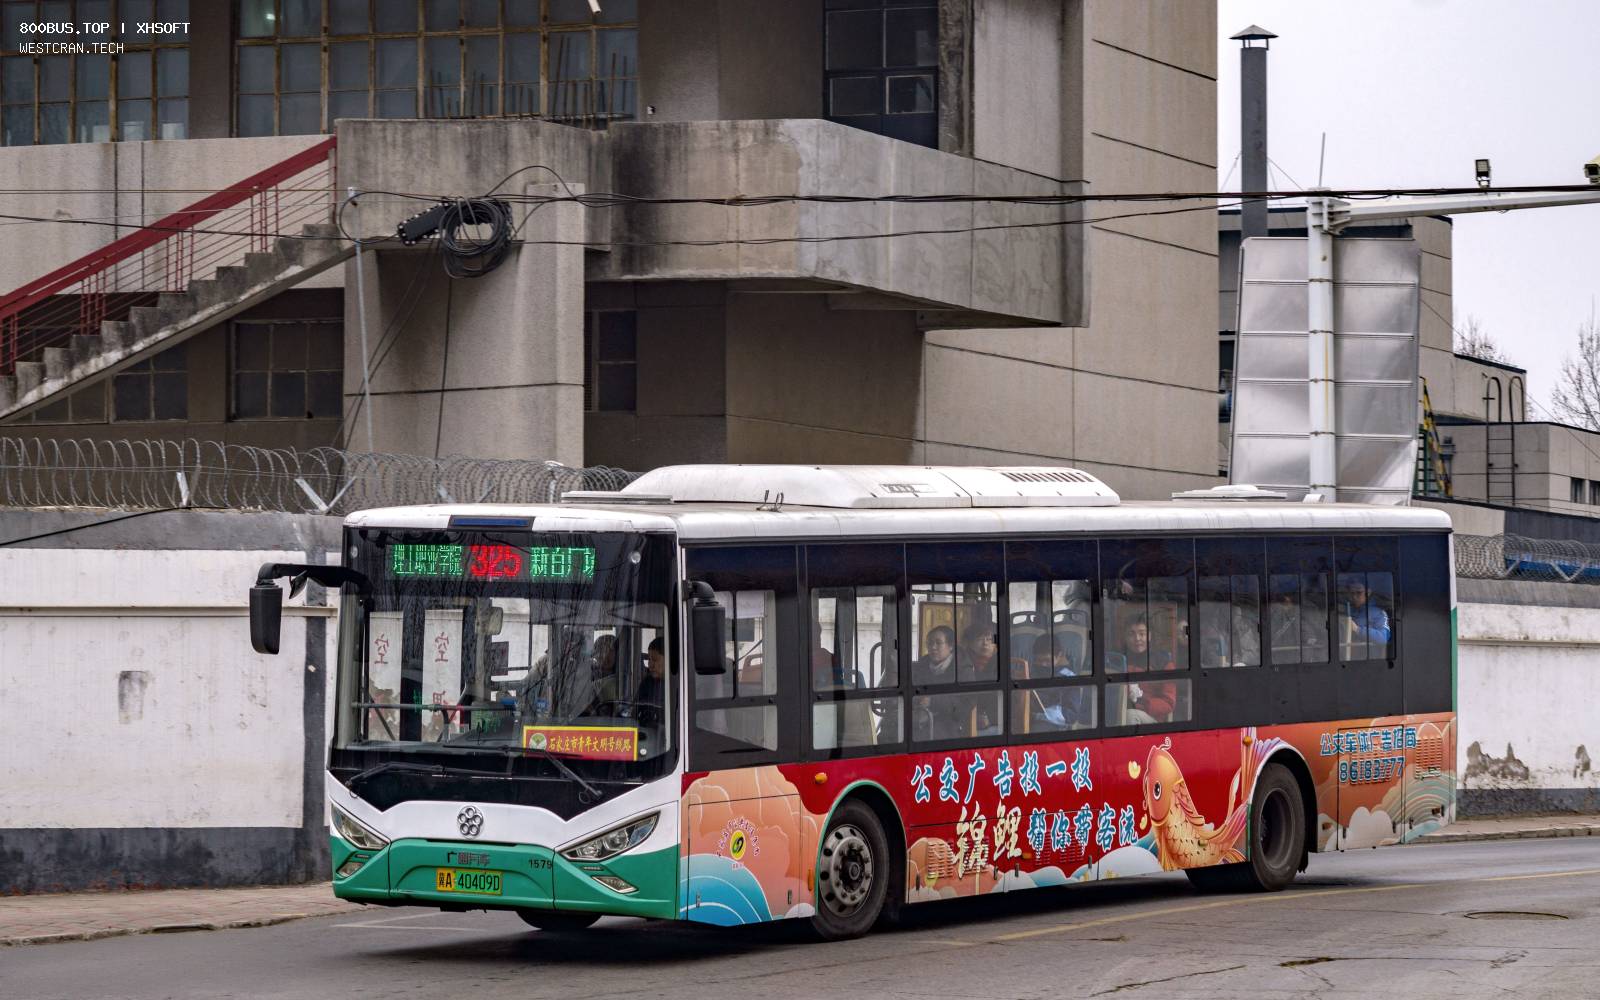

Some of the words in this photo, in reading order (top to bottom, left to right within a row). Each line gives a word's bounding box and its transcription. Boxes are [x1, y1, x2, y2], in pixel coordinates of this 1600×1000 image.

[470, 544, 522, 577] 325
[1320, 727, 1417, 756] 公交车体广告招商
[911, 747, 1093, 804] 公交广告投一投
[1339, 756, 1405, 784] 86183777
